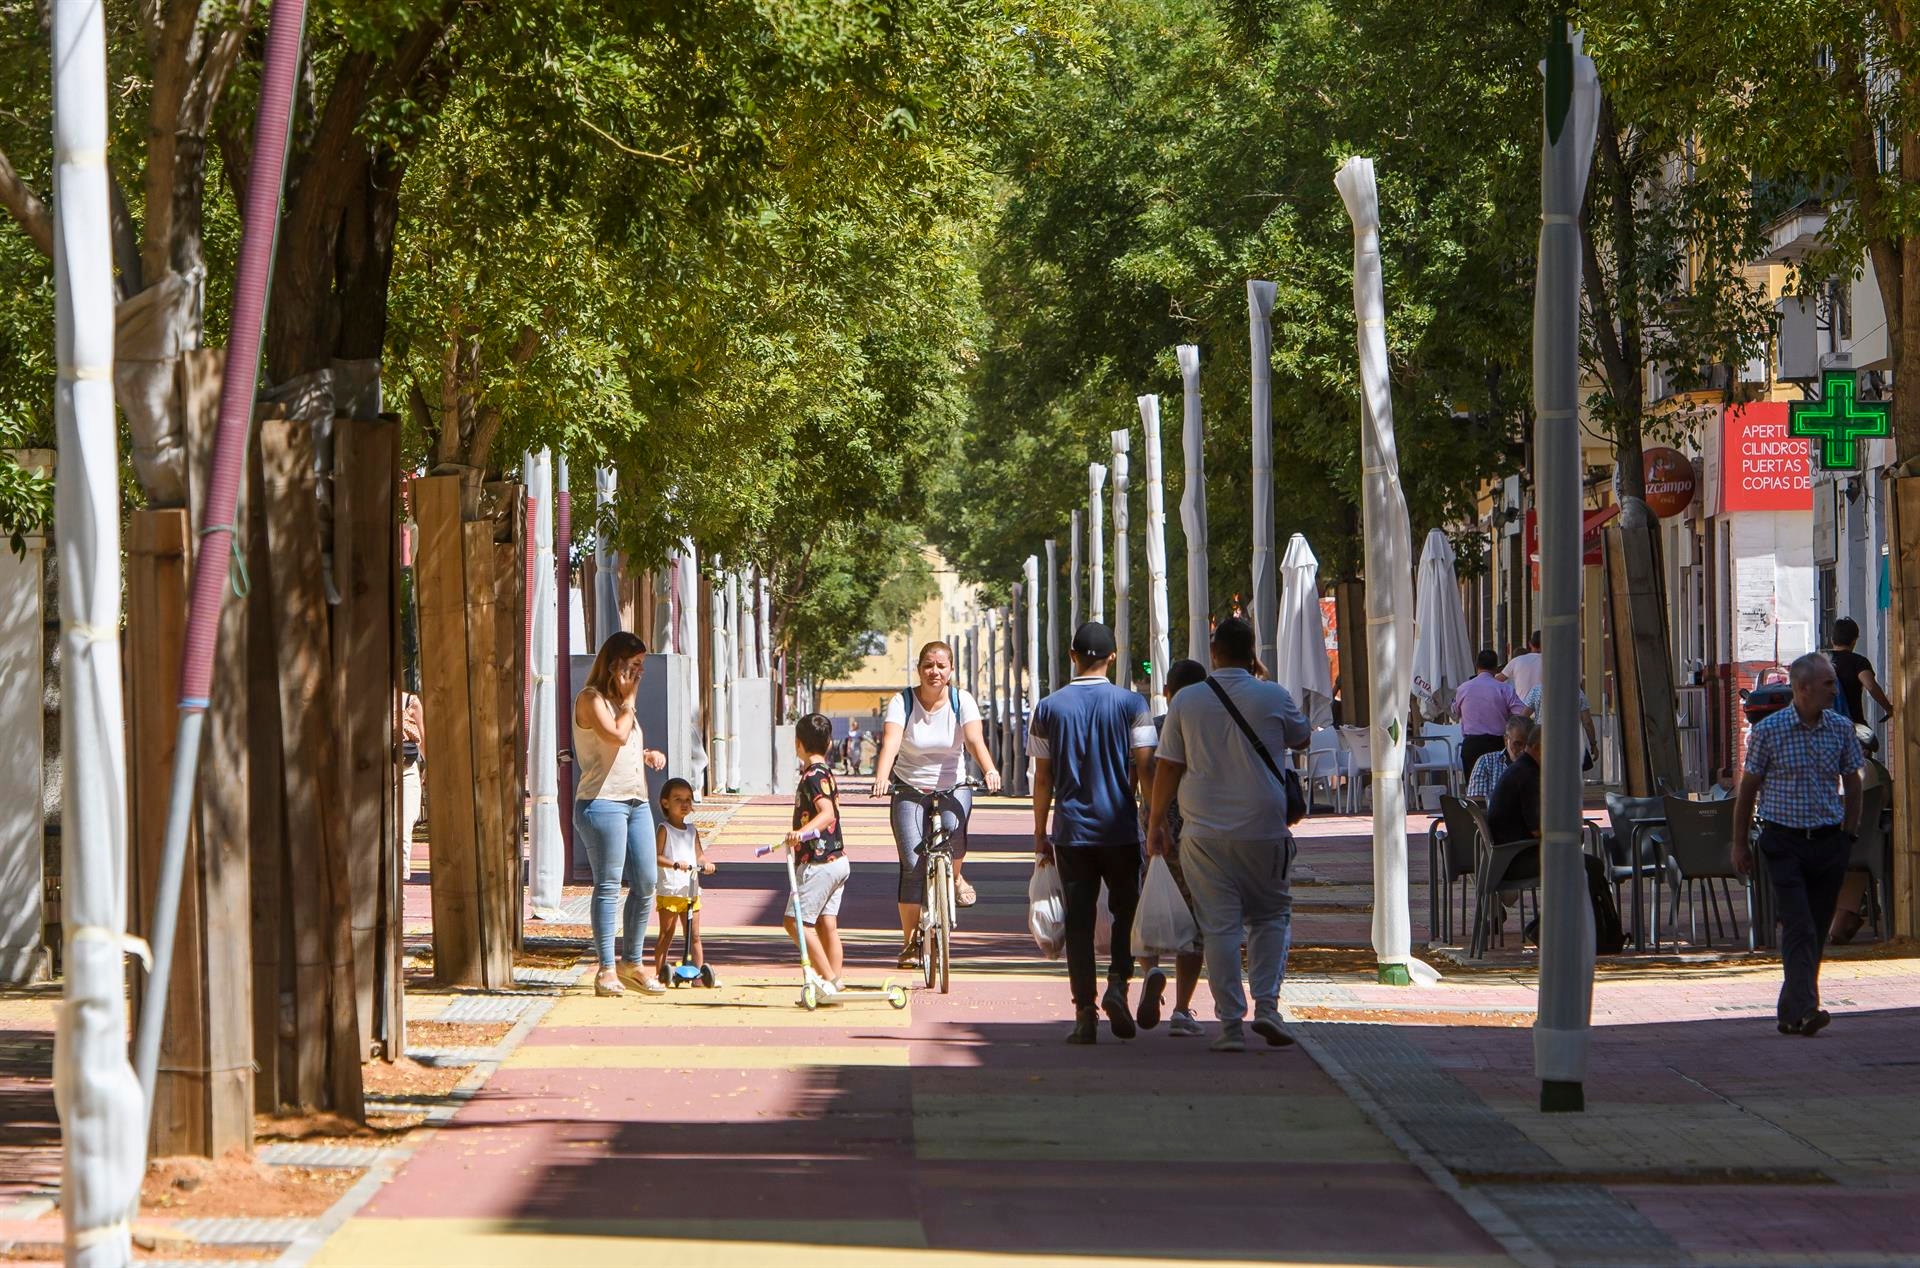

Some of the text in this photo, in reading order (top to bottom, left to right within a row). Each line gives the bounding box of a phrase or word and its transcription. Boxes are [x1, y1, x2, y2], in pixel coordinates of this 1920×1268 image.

[1742, 442, 1807, 455] CILINDROS
[1742, 459, 1801, 472] PUERTAS
[1742, 476, 1811, 490] COPIAS DE
